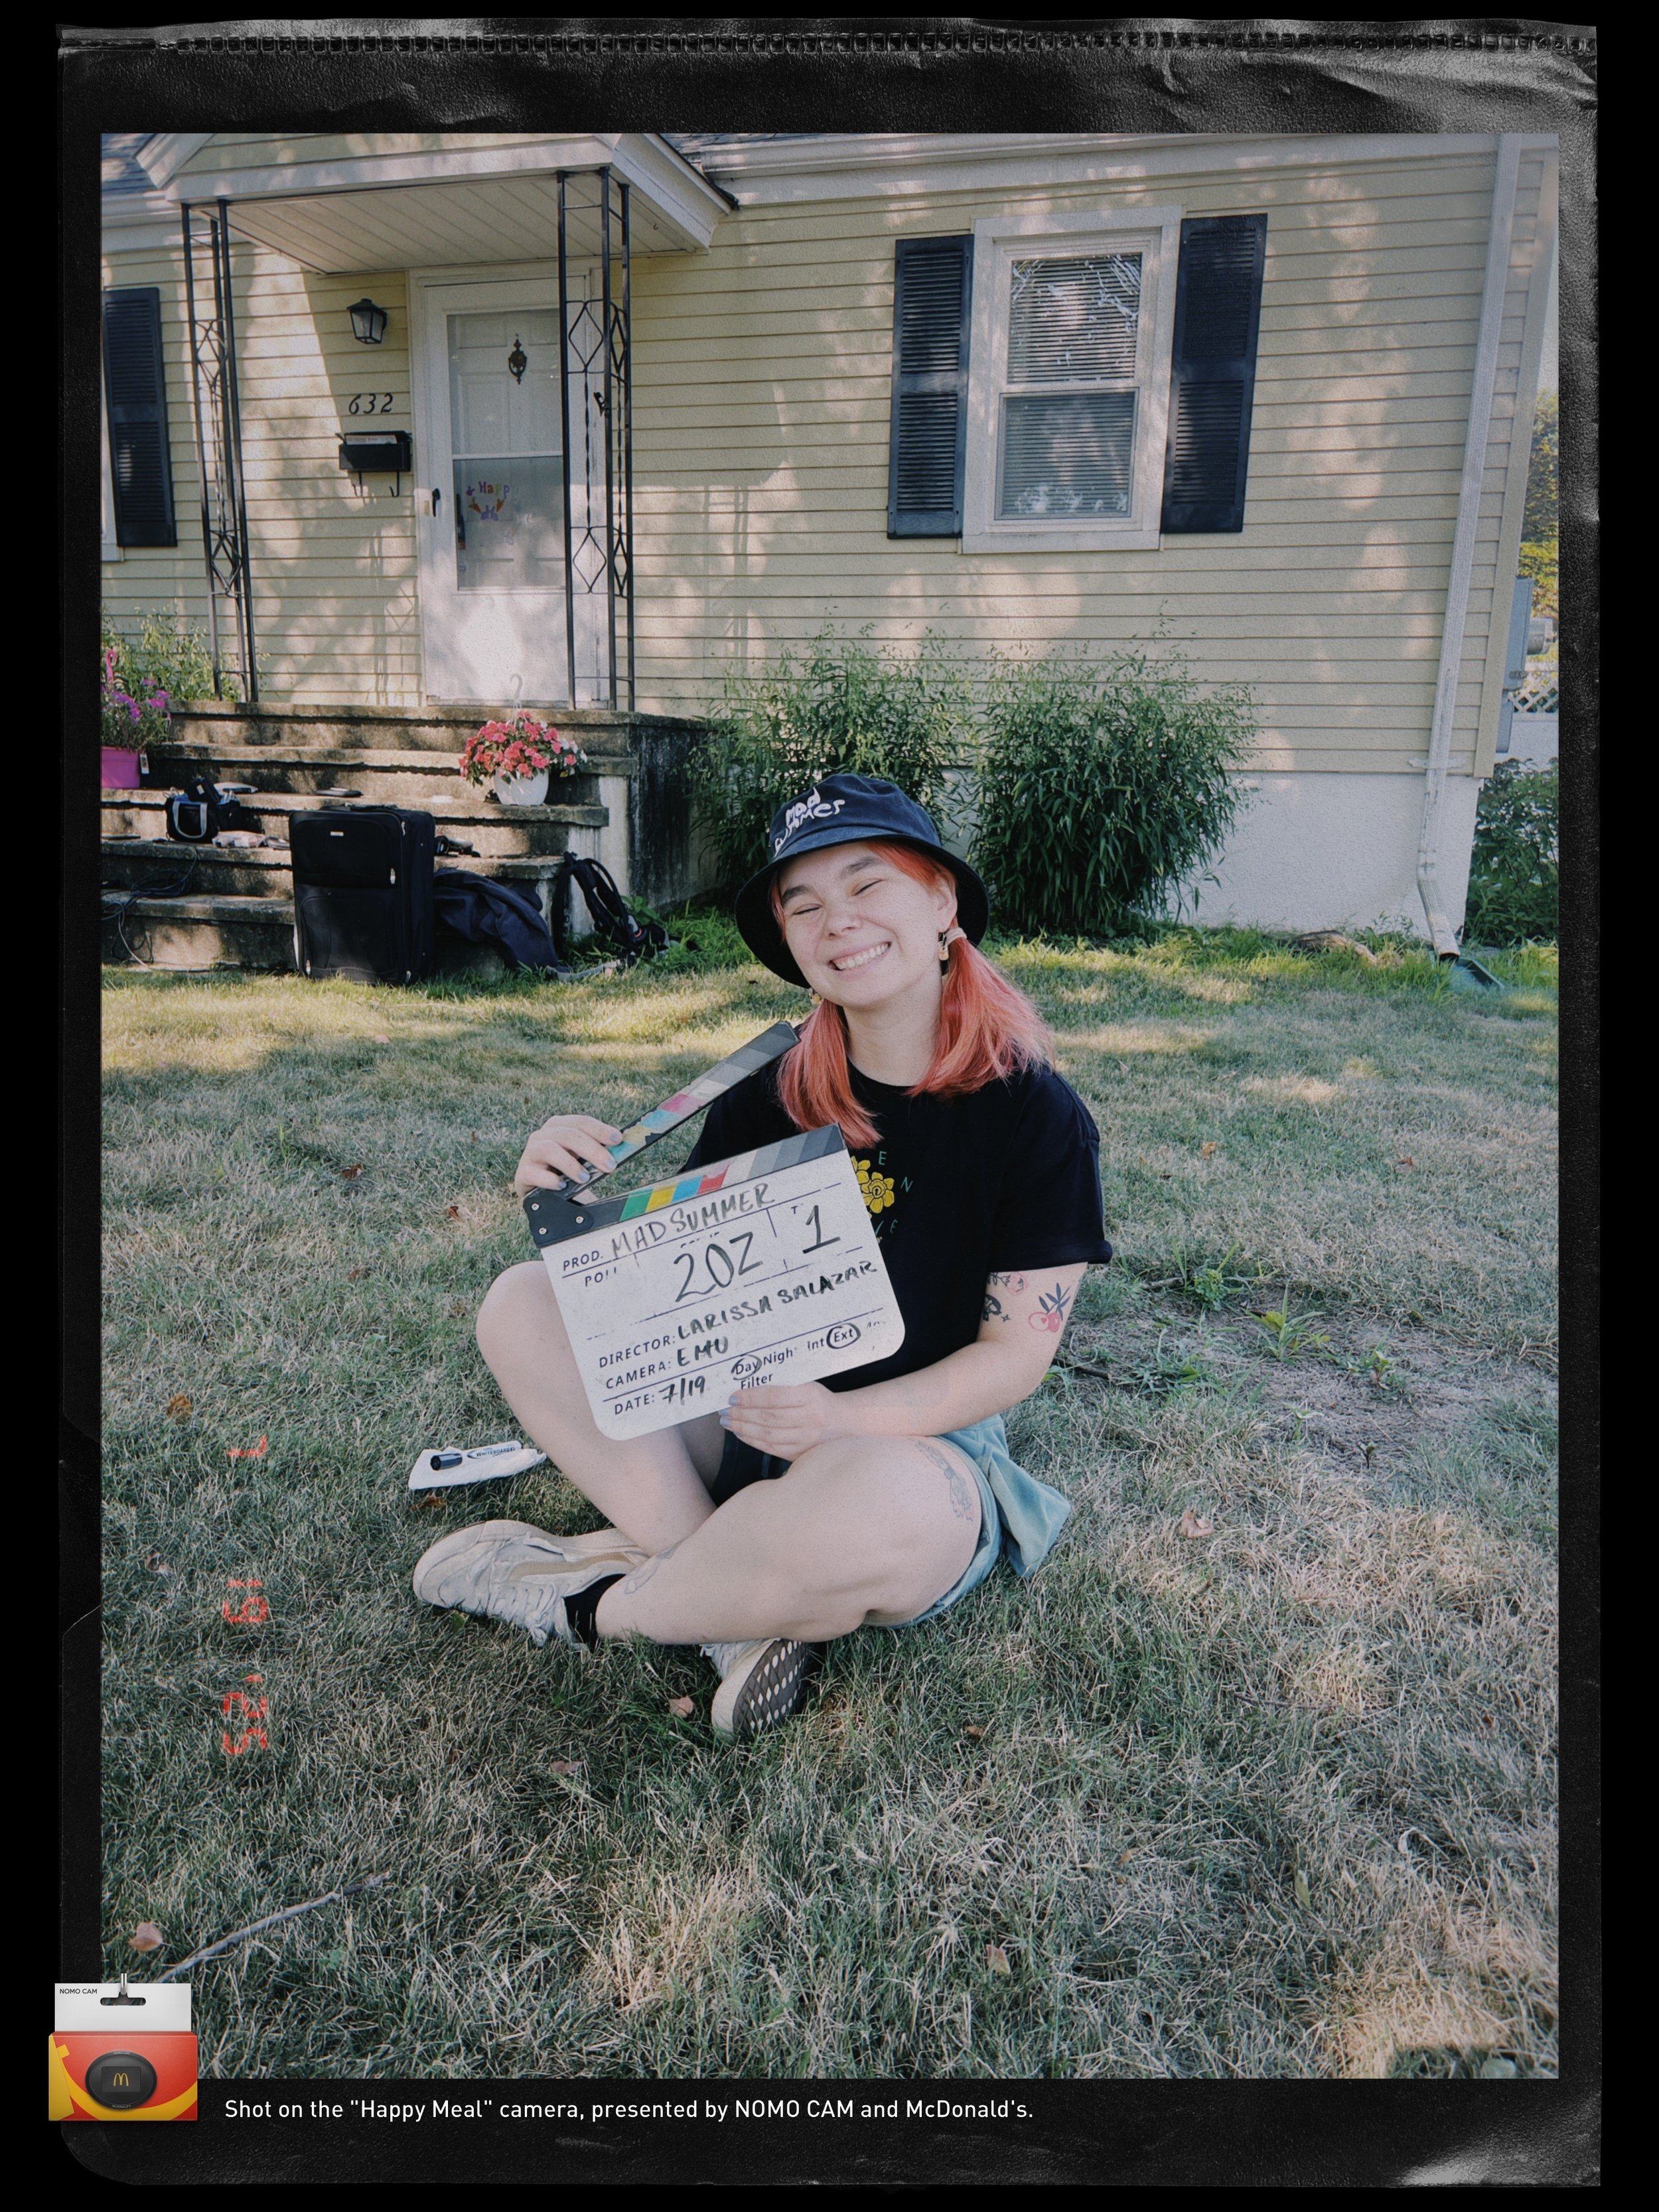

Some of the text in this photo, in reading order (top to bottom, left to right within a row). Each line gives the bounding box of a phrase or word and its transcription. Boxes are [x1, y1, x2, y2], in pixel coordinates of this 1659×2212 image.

[348, 392, 393, 415] 632
[478, 481, 519, 500] Happ
[612, 1183, 775, 1259] MAD SUMMER
[802, 1205, 841, 1254] 1
[563, 1250, 603, 1271] PROD.
[678, 1261, 877, 1340] LARISSA SALAZAR
[599, 1335, 676, 1368] DIRECTOR:
[735, 1328, 854, 1375] Day Nigh Int Ext
[606, 1361, 671, 1389] CAMERA:
[740, 1372, 774, 1391] Filter
[614, 1394, 655, 1415] DATE:
[658, 1375, 706, 1406] 7/19
